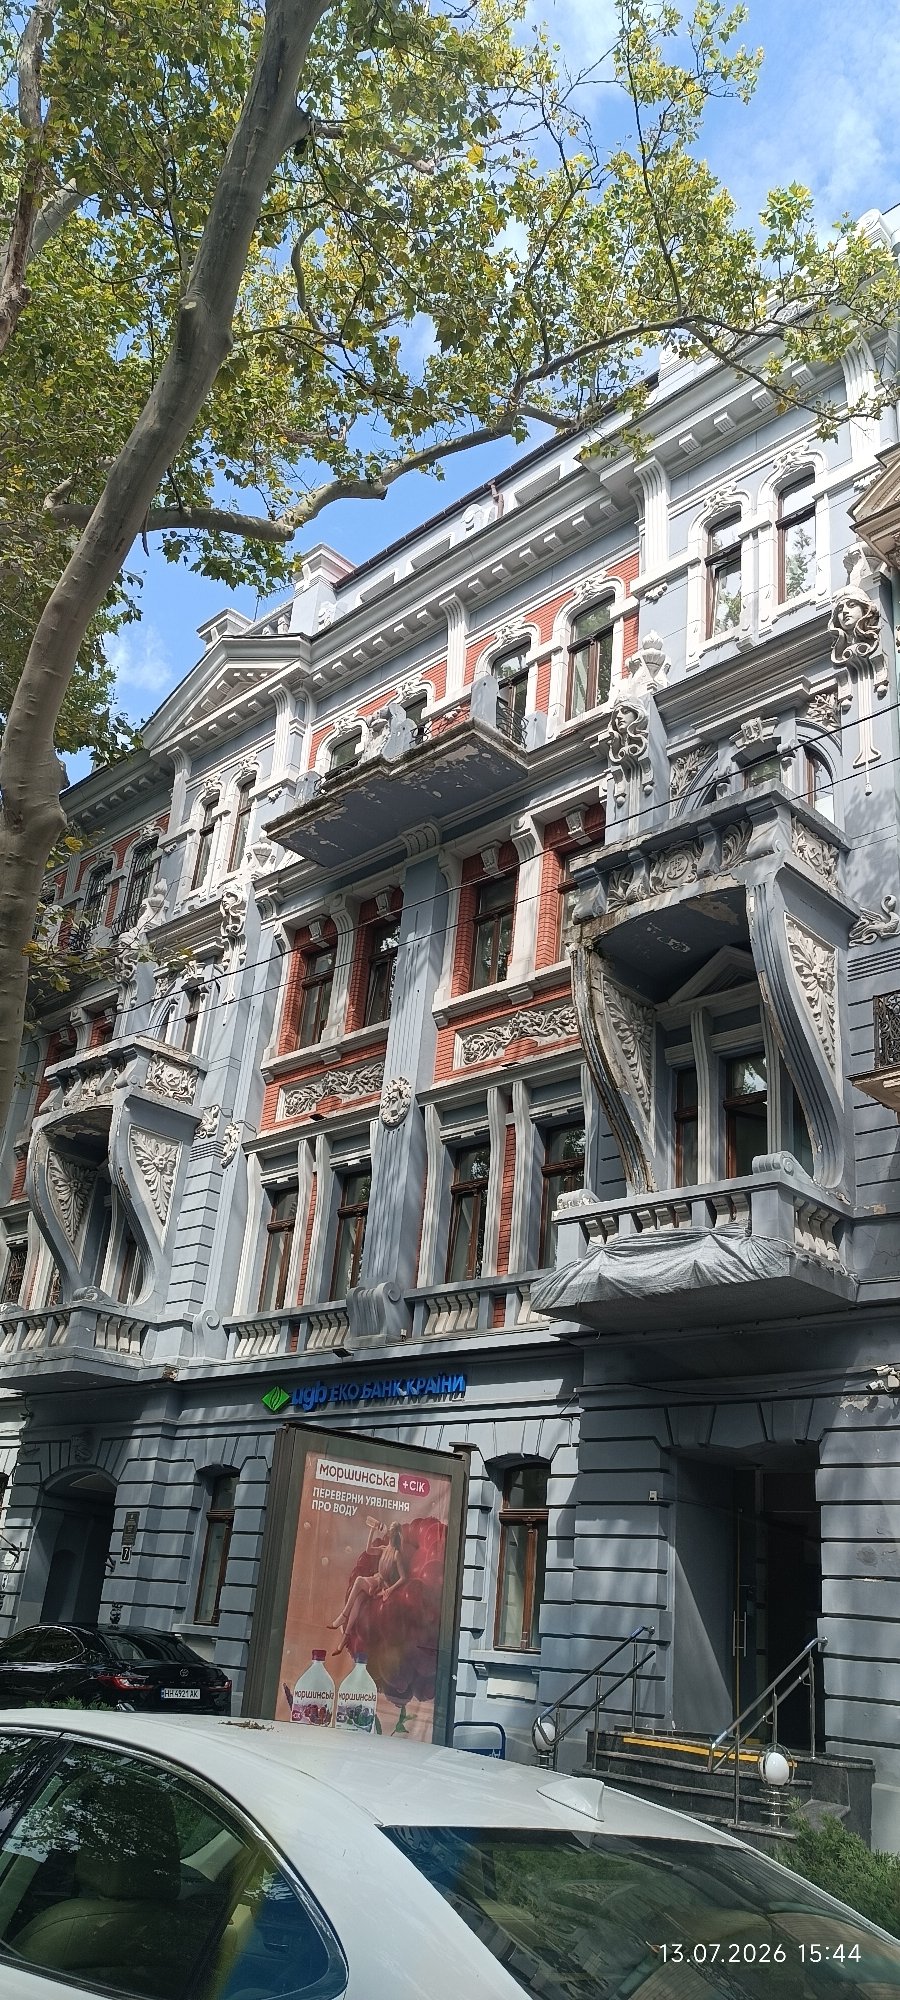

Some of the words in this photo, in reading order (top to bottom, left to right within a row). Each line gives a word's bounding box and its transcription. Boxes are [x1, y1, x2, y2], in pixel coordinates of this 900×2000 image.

[329, 1382, 360, 1402] ЕКО
[360, 1379, 406, 1400] БАНК
[406, 1373, 465, 1395] КРАЇНИ
[319, 1462, 396, 1488] моршинська
[311, 1499, 332, 1512] ПРО
[333, 1502, 358, 1516] ВОДУ
[312, 1487, 364, 1504] ПЕРЕВЕРНИ
[365, 1495, 410, 1512] УЯВЛЕННЯ
[175, 1689, 189, 1698] 4921
